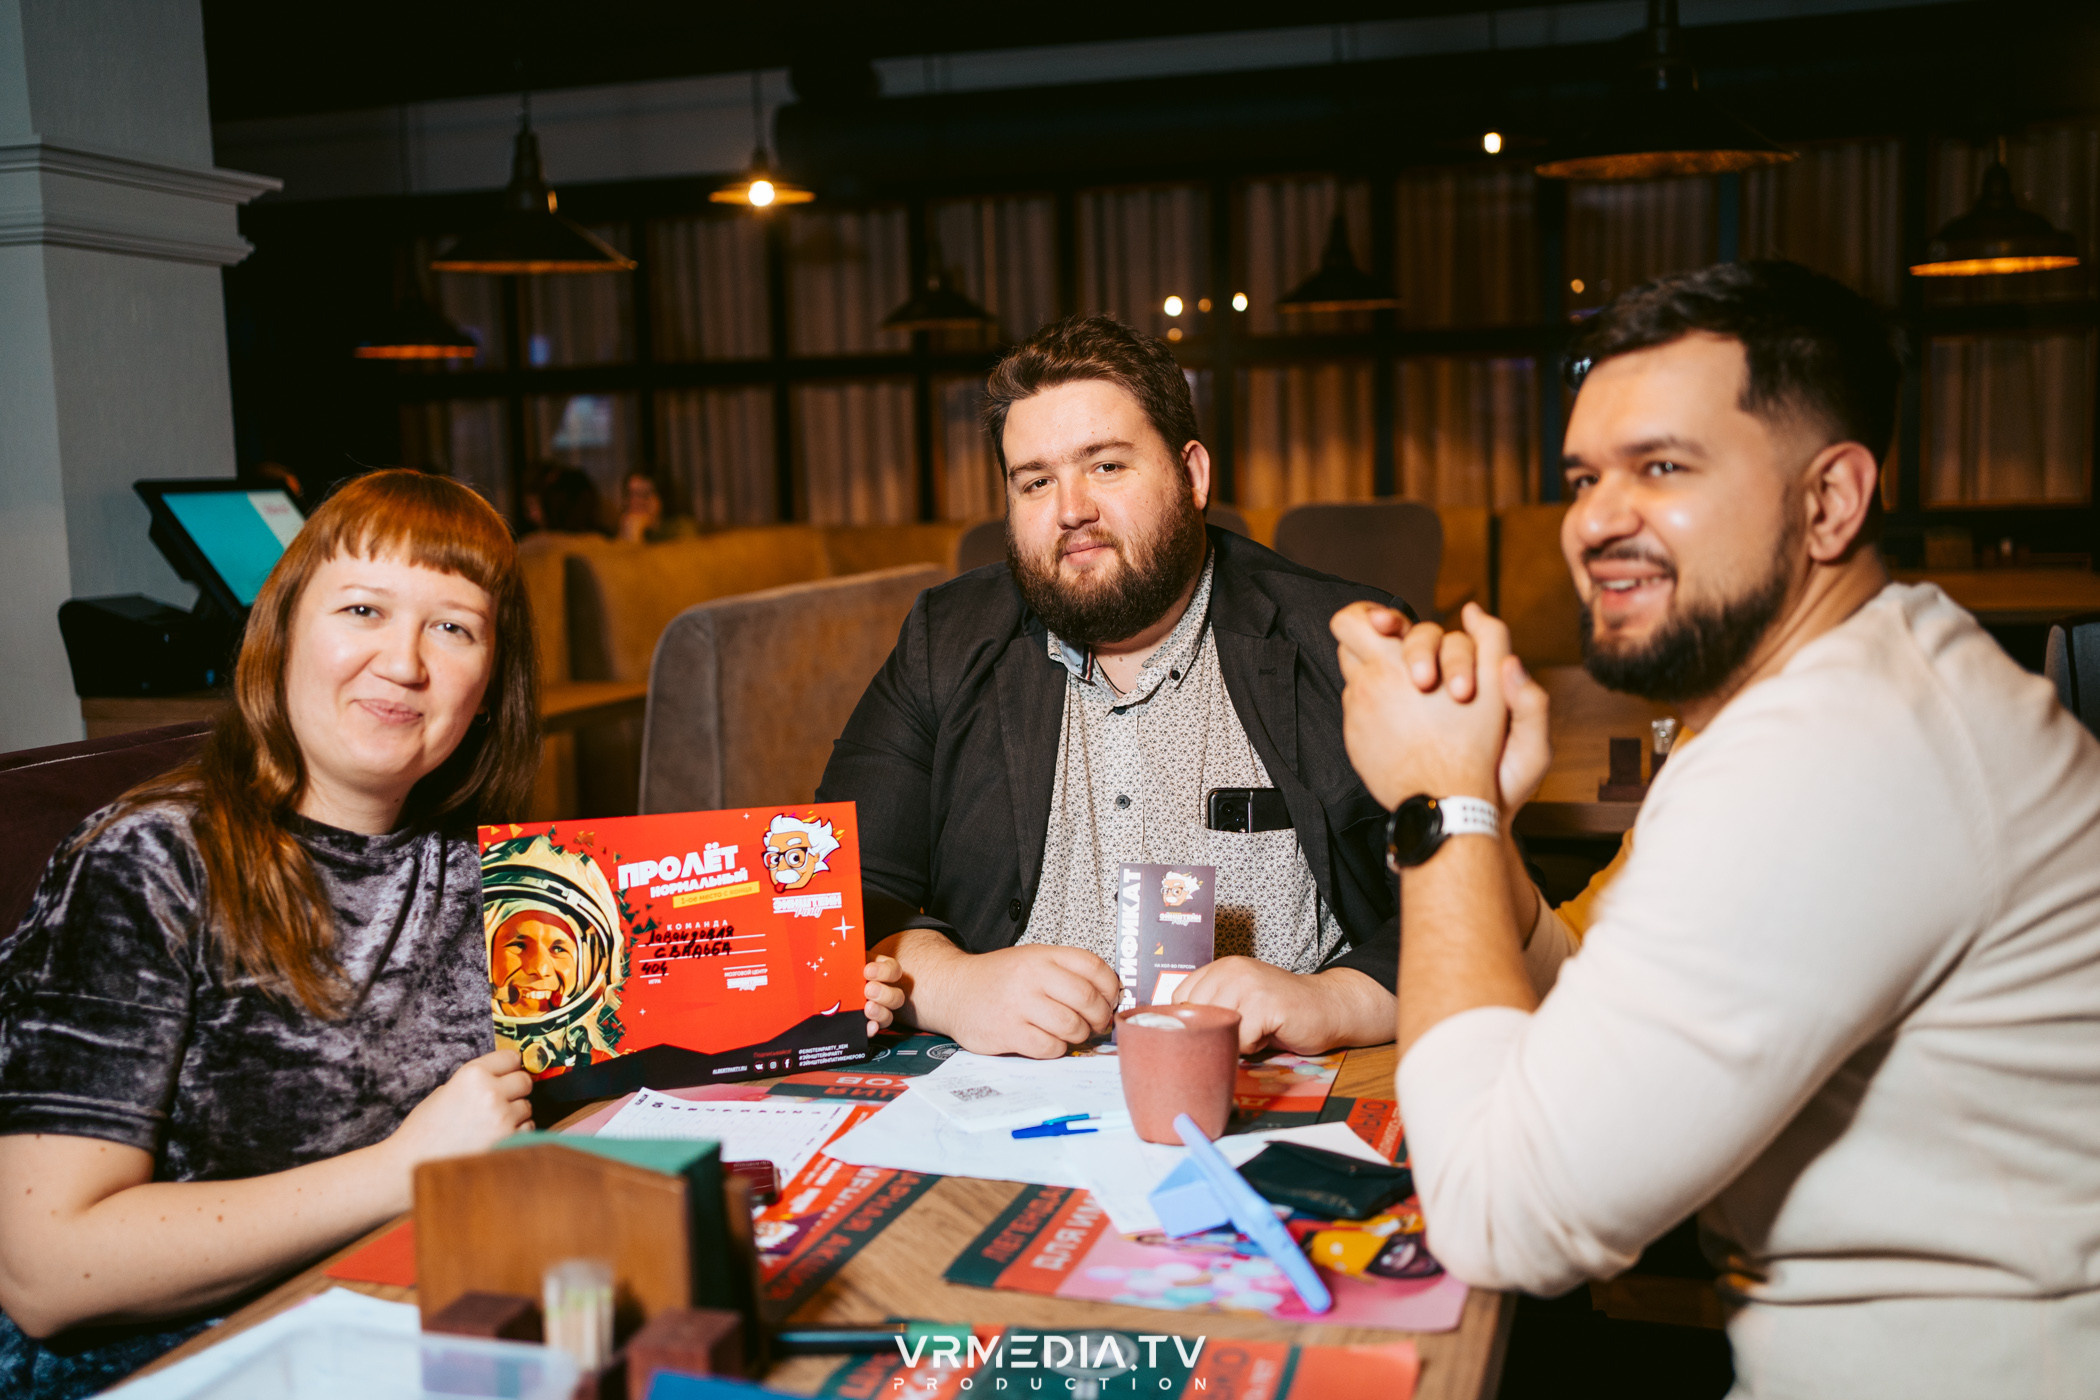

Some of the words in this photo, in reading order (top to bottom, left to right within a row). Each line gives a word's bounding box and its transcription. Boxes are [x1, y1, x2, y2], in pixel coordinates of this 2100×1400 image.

[618, 841, 739, 890] ПРОЛЁТ
[650, 867, 748, 898] НОРМАЛЬНЫЙ
[667, 920, 728, 931] КОМАНДА
